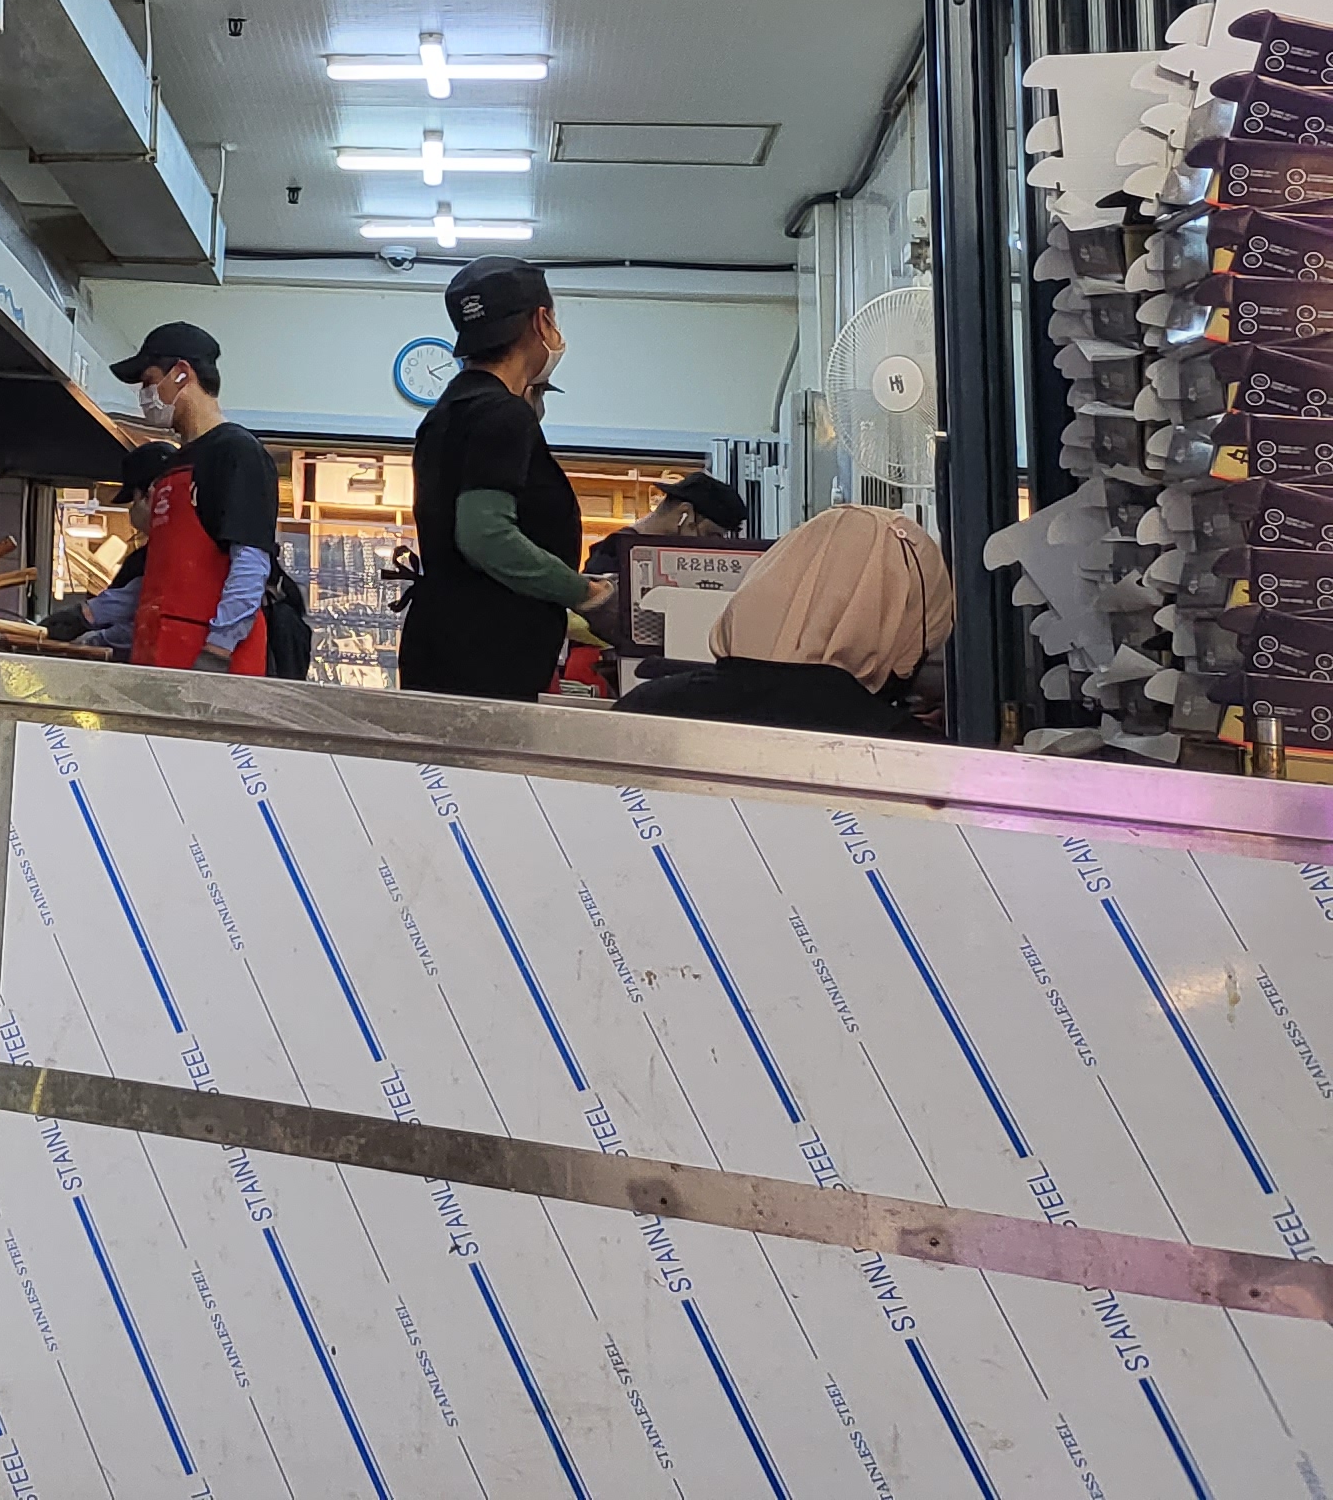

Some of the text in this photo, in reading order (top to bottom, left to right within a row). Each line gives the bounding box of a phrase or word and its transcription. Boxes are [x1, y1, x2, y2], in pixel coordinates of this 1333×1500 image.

[188, 833, 244, 950] STAINLESS STEEL
[378, 855, 438, 975] STAINLESS STEEL
[578, 880, 644, 1003] STAINLESS STEEL
[789, 905, 859, 1034] STAINLESS STEEL
[1019, 933, 1097, 1067] STAINLESS STEEL
[1257, 964, 1289, 1016] STEEL
[4, 1228, 58, 1352] STAINLESS STEEL
[191, 1260, 250, 1388] STAINLESS STEEL
[395, 1295, 458, 1428] STAINLESS STEEL
[604, 1332, 673, 1470] STAINLESS STEEL
[825, 1372, 855, 1426] STEEL
[1055, 1413, 1087, 1469] STEEL
